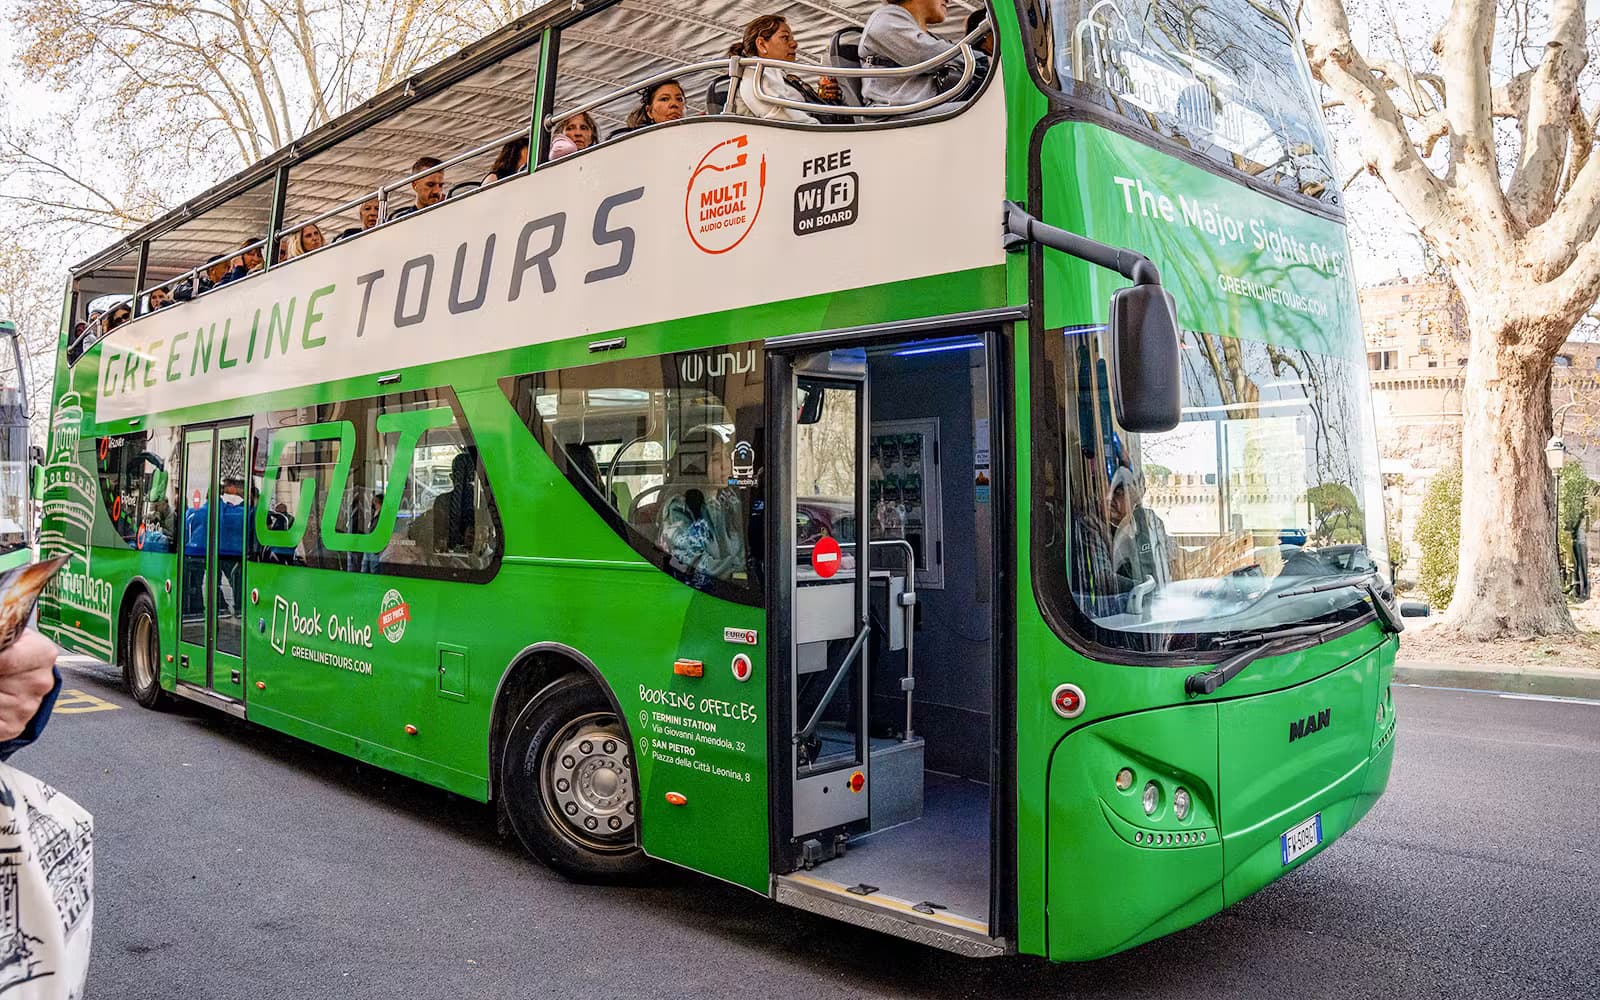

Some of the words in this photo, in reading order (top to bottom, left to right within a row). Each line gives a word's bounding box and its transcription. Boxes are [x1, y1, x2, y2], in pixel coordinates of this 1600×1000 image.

[803, 149, 851, 178] FREE
[700, 181, 747, 208] MULTI
[797, 182, 850, 213] WiFi
[700, 200, 747, 222] LINGUAL
[700, 220, 722, 234] AUDIO
[724, 215, 746, 228] GUIDE
[799, 219, 814, 231] ON
[816, 210, 853, 228] BOARD
[1113, 176, 1174, 222] The
[1178, 195, 1245, 246] Major
[1250, 219, 1308, 263] Sights
[1310, 242, 1330, 272] Of
[103, 283, 336, 397] GREENLINE
[357, 186, 645, 337] TOURS
[1217, 273, 1328, 317] GREENLINETOURS.COM
[291, 601, 323, 637] Book
[327, 614, 373, 648] Online
[291, 646, 372, 675] GREENLINETOURS.COM
[639, 684, 695, 710] BOOKING
[700, 699, 757, 723] OFFICES
[652, 711, 682, 726] TERMINI
[683, 717, 717, 733] STATION
[1289, 709, 1331, 743] MAN
[652, 724, 663, 734] Via
[664, 726, 694, 740] Giovanni
[695, 733, 735, 751] Amendola,
[735, 741, 746, 752] 32
[652, 738, 667, 750] SAN
[668, 743, 696, 756] PIETRO
[652, 750, 674, 764] Piazza
[675, 754, 692, 768] della
[693, 760, 711, 773] Città
[712, 763, 744, 782] Leonina,
[744, 772, 751, 783] 8
